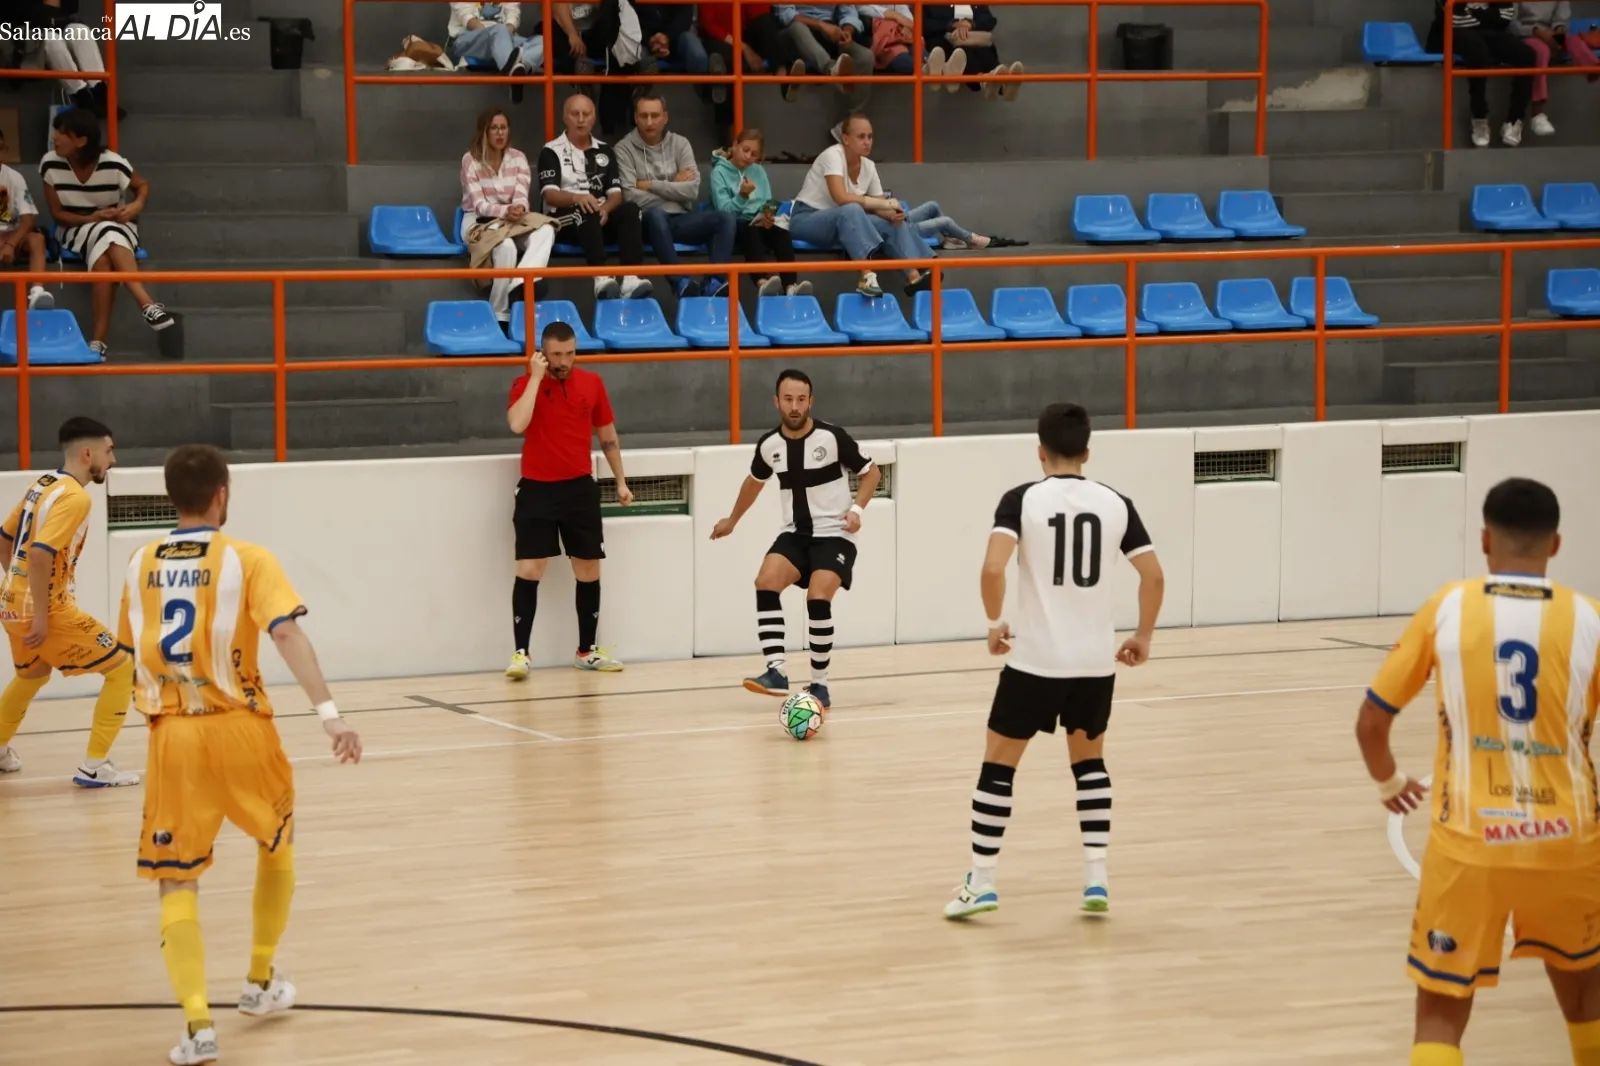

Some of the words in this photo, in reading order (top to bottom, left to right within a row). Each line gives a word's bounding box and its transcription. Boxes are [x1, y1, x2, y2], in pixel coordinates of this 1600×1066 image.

[146, 568, 212, 590] ALVARO
[1048, 512, 1102, 588] 10
[160, 598, 196, 665] 2
[1495, 638, 1540, 724] 3
[1484, 817, 1569, 842] MACIAS
